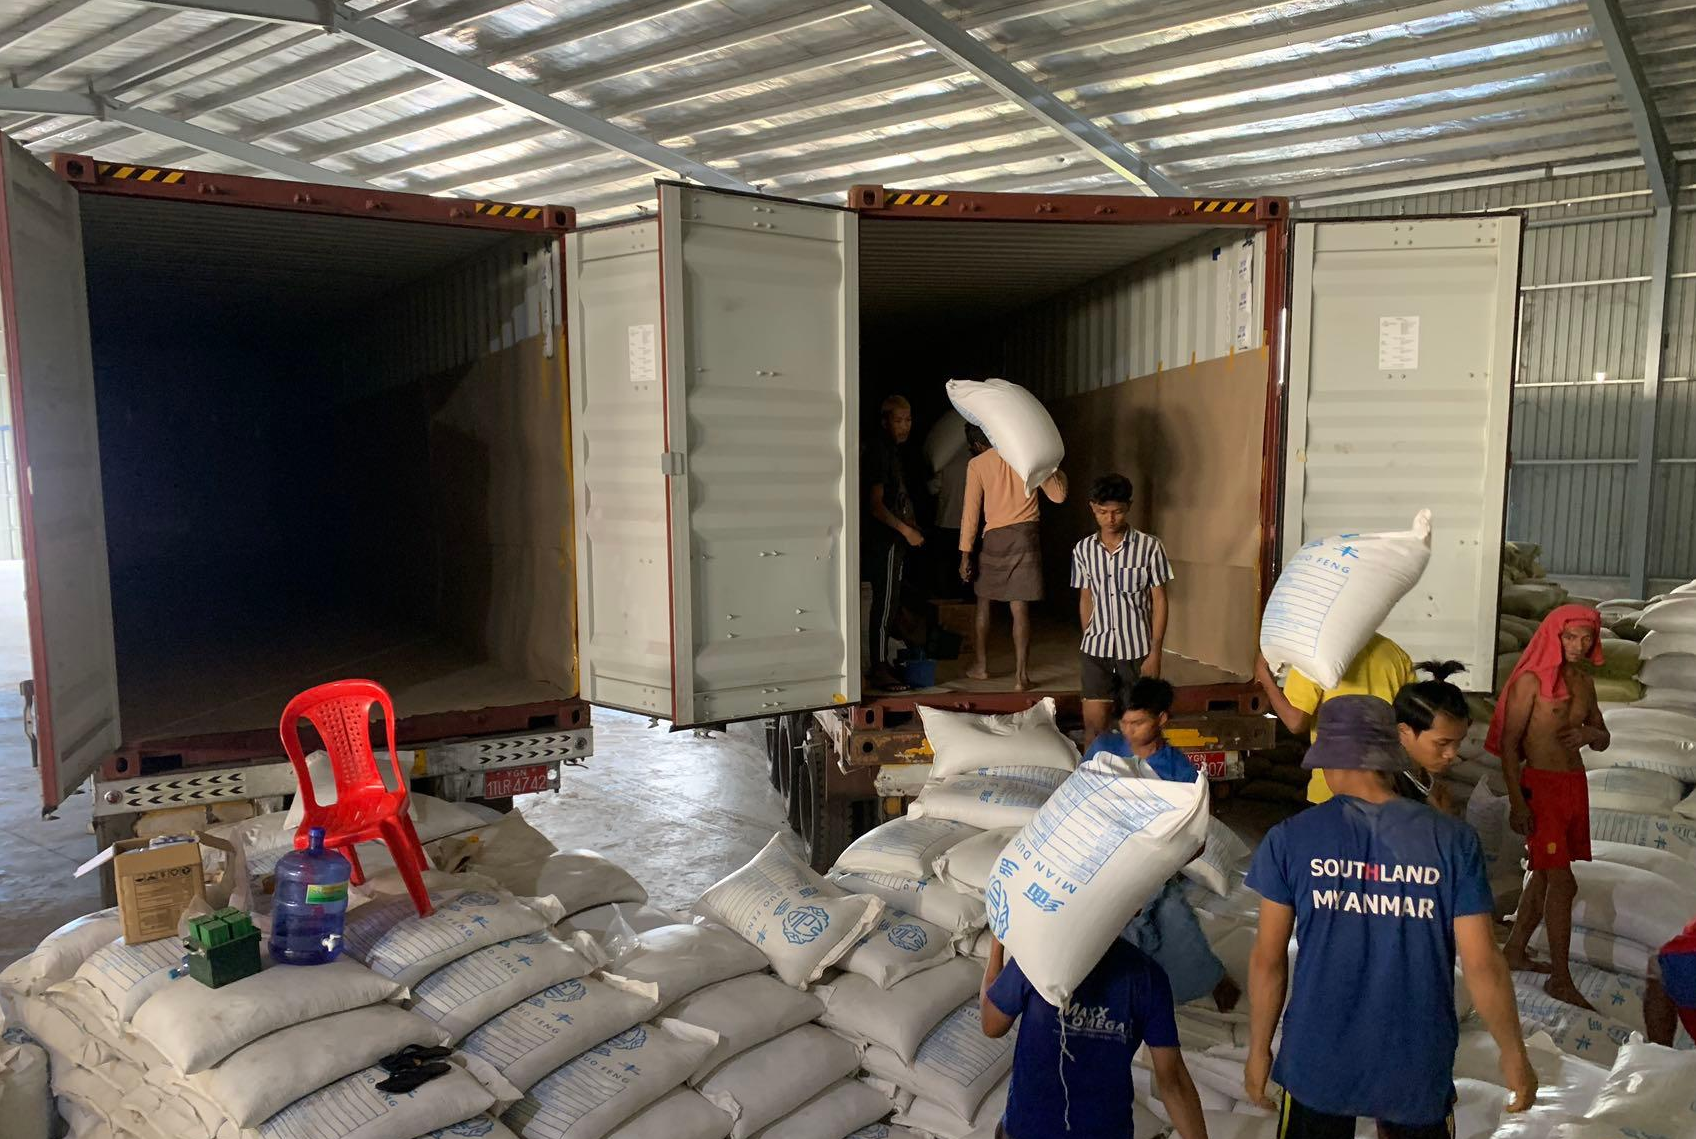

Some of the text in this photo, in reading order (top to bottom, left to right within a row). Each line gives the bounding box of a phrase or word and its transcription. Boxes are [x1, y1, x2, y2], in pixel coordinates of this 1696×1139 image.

[1316, 557, 1350, 574] FENG
[1187, 754, 1207, 762] YGN
[506, 769, 527, 777] YGN
[1033, 860, 1078, 895] MIAN
[1310, 858, 1440, 885] SOUTHLAND
[1312, 889, 1435, 919] MYANMAR
[1071, 1016, 1126, 1034] OMEGA
